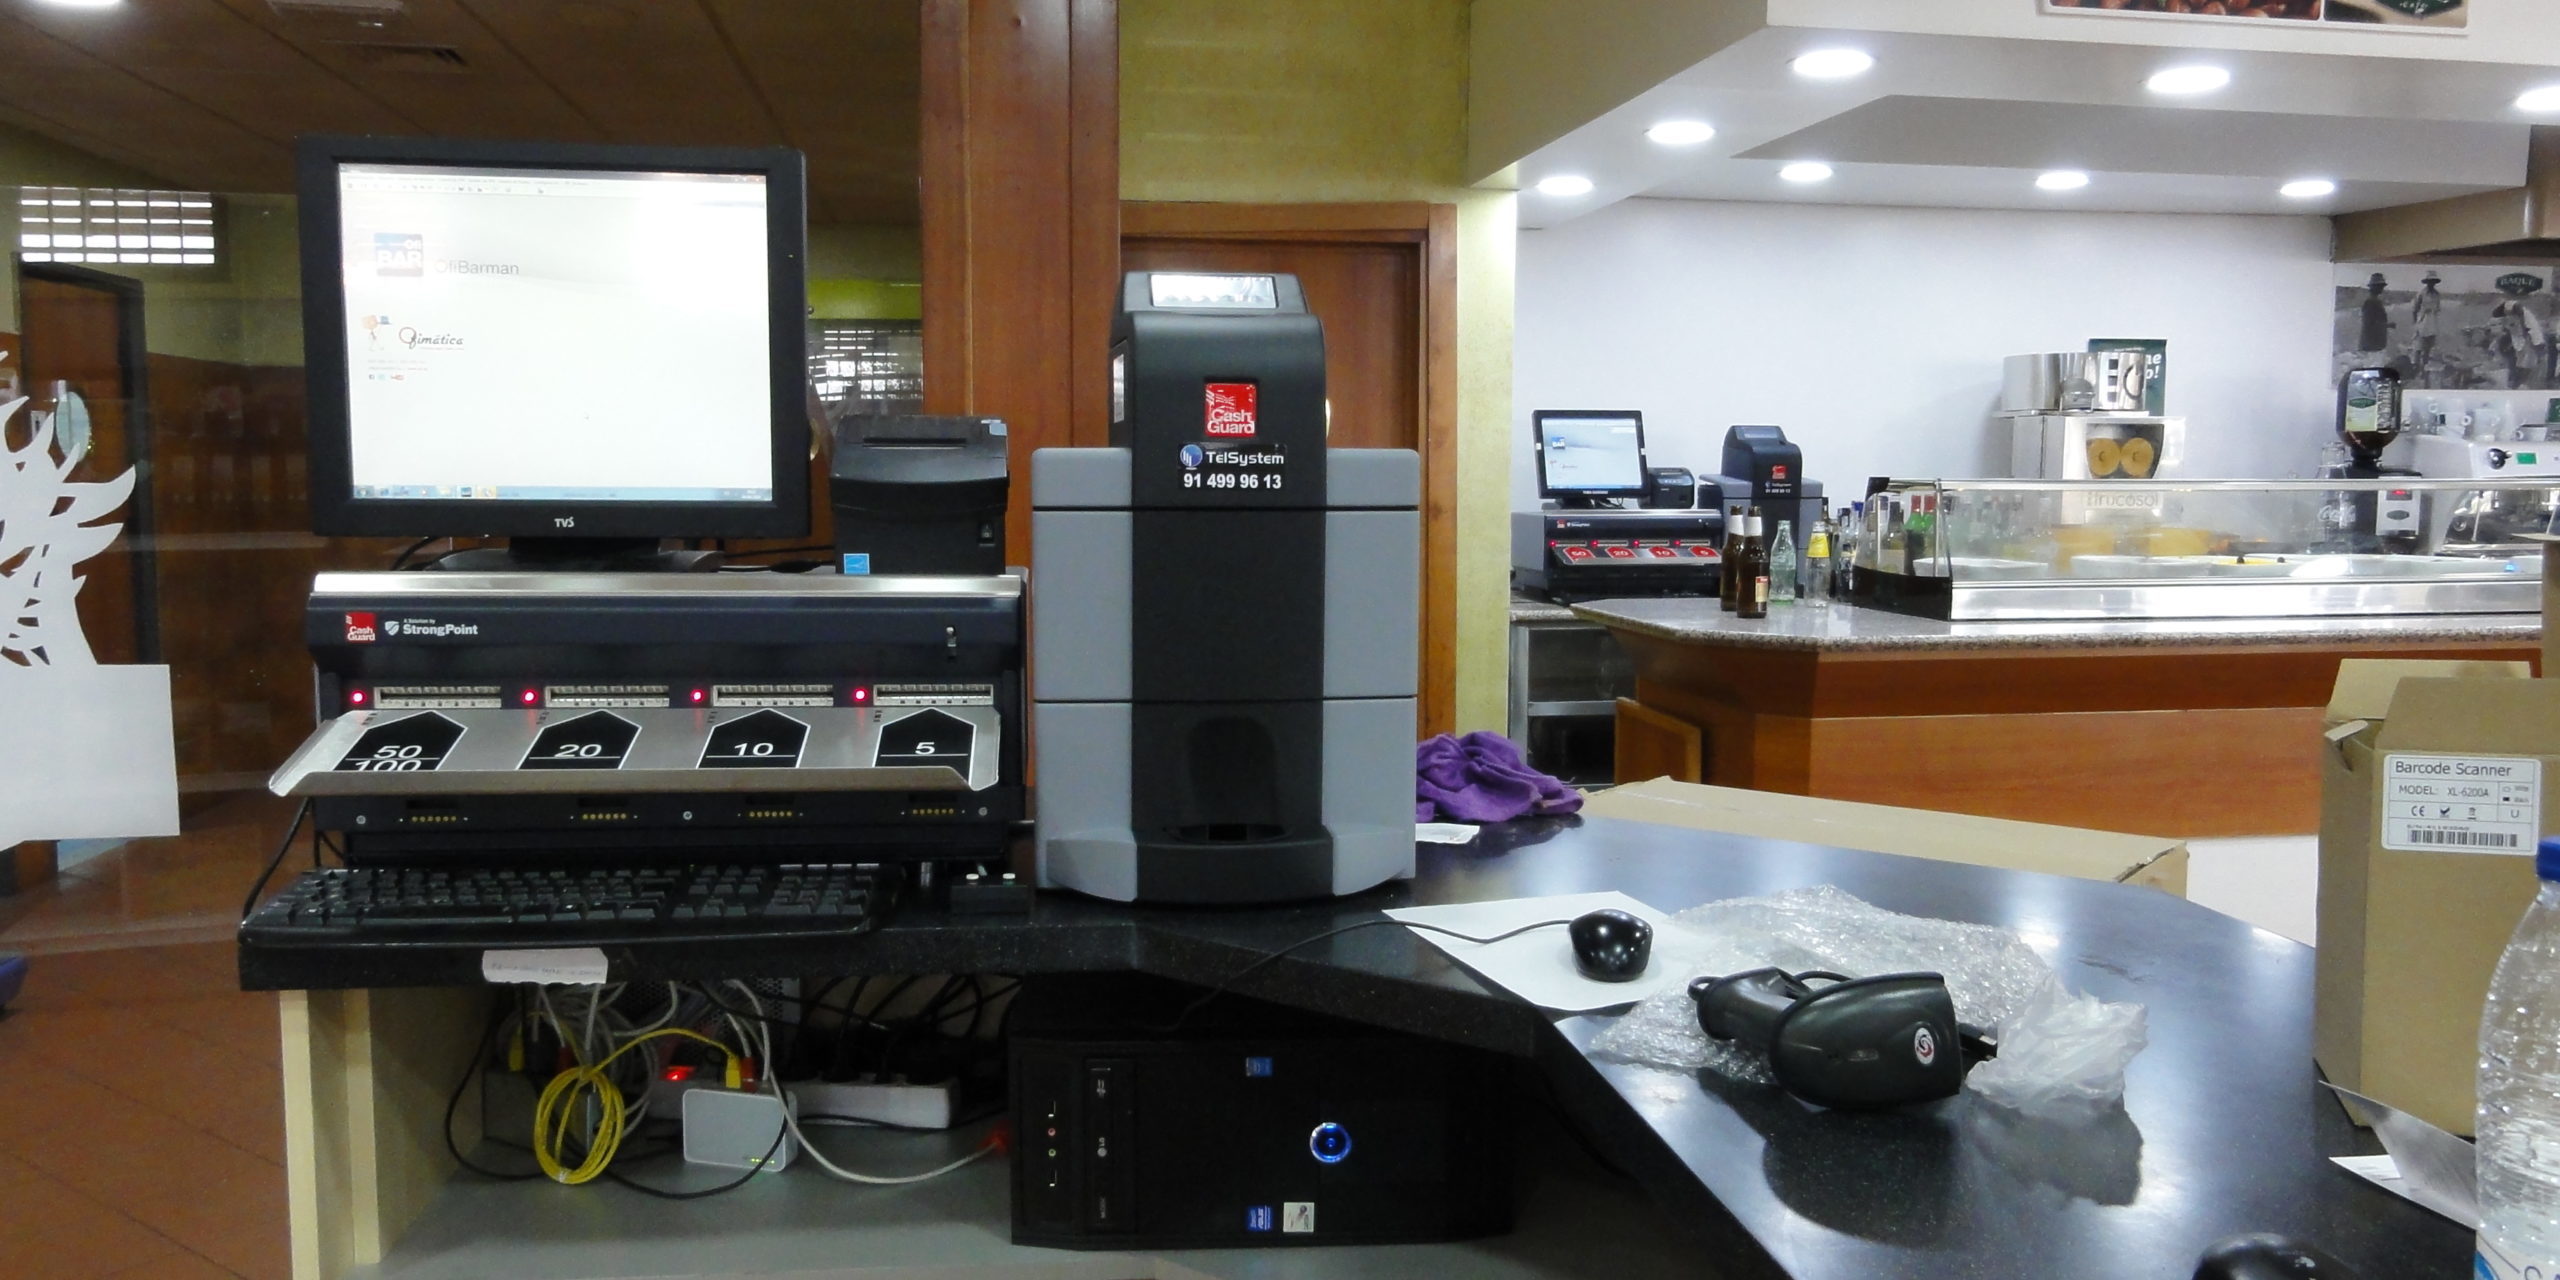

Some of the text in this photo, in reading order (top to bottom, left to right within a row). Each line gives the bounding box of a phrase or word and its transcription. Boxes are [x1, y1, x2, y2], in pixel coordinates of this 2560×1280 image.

[377, 250, 422, 268] BAR
[1210, 408, 1253, 422] Cash
[1206, 419, 1255, 434] Guard
[1205, 451, 1285, 467] TelSystem
[1183, 473, 1283, 490] 91 499 96 13
[1613, 549, 1629, 557] 20
[1656, 549, 1671, 557] 10
[347, 632, 376, 641] Guard
[349, 626, 373, 634] Cash
[402, 623, 479, 637] StrongPoint
[373, 744, 423, 760] 50
[553, 743, 602, 758] 20
[733, 742, 775, 757] 10
[914, 741, 936, 755] 5
[353, 759, 423, 772] 100
[2395, 761, 2512, 777] Barcode Scanner
[2398, 784, 2439, 796] MODEL:
